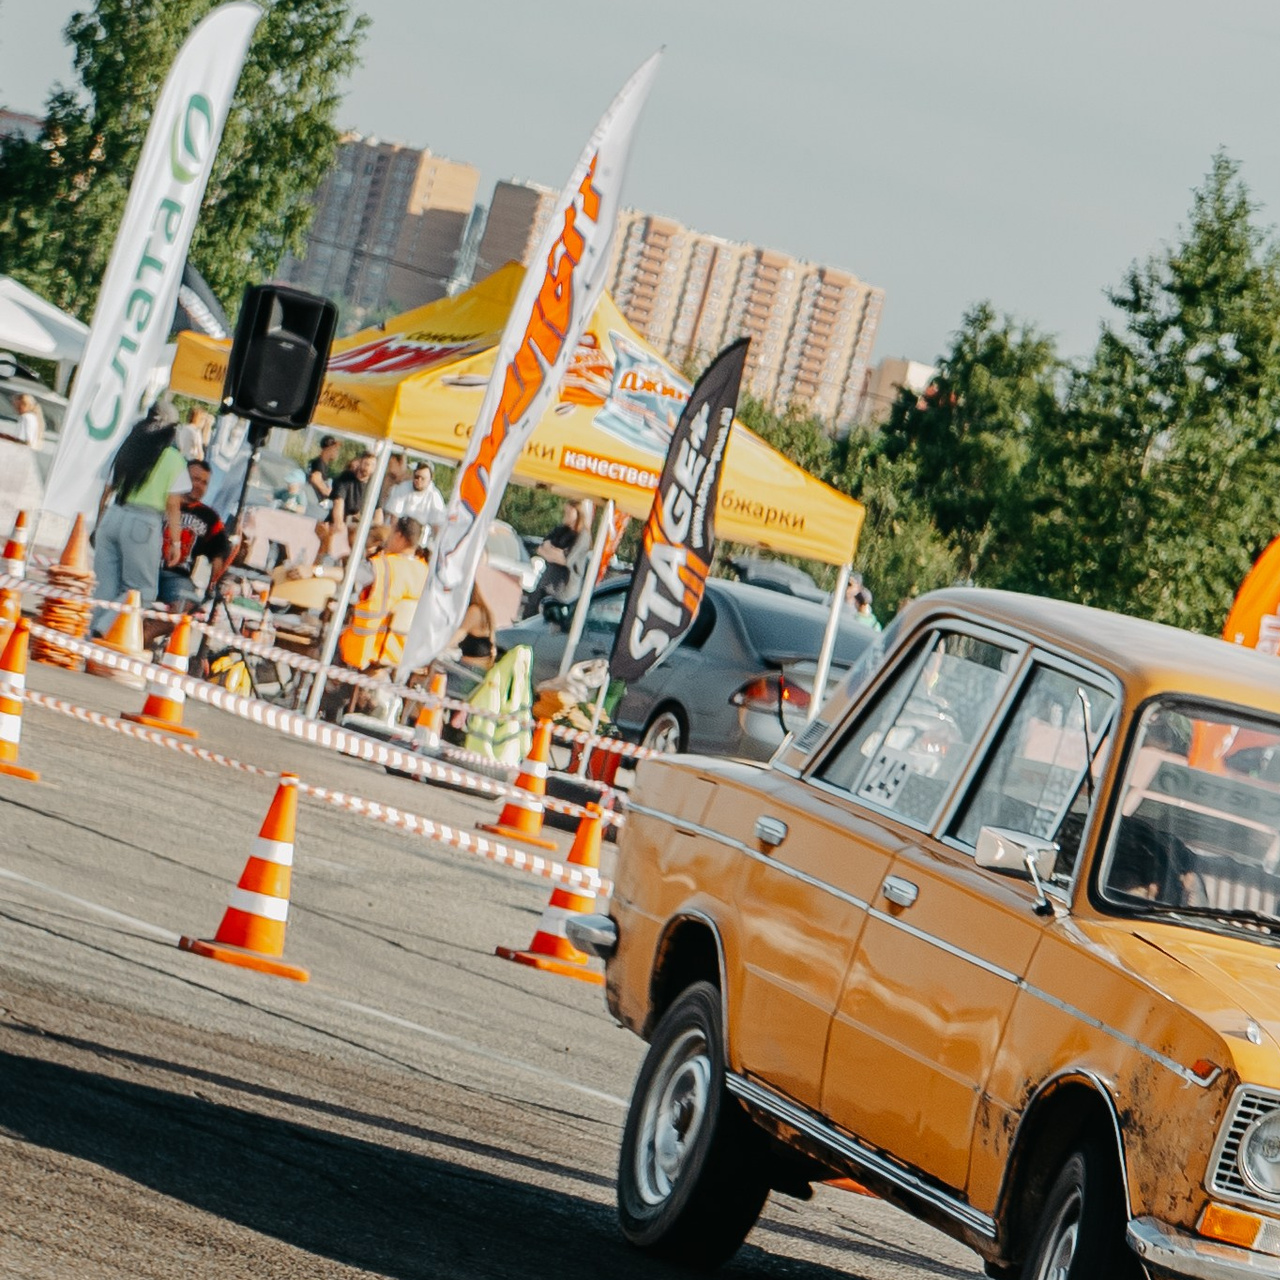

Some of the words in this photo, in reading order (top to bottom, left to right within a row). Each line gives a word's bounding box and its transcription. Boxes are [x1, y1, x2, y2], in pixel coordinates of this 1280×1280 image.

[85, 197, 184, 441] Слата
[563, 449, 660, 489] качествен
[720, 489, 806, 530] бжарки
